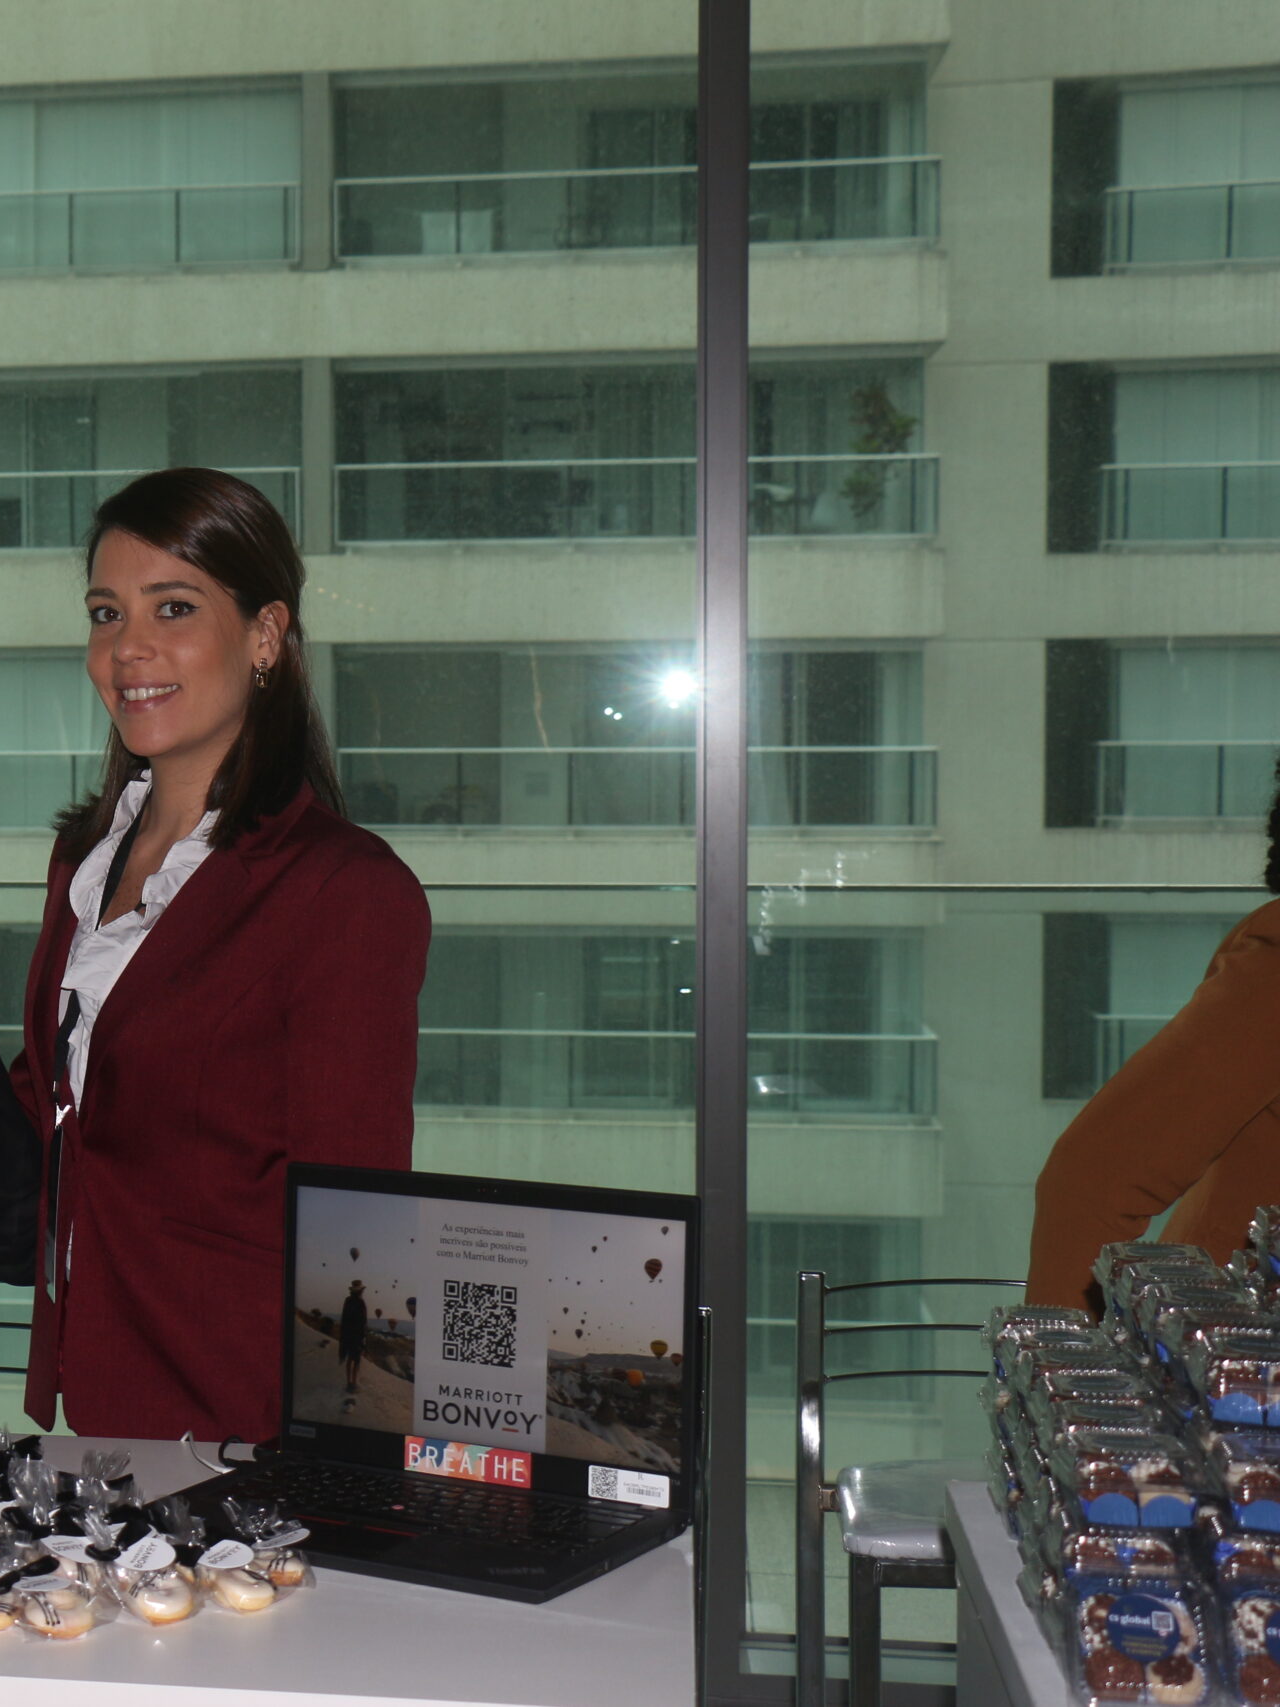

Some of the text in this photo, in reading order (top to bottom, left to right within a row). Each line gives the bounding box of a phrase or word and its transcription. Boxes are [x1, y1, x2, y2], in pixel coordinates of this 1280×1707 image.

[442, 1223, 453, 1232] As
[506, 1230, 525, 1239] mais
[475, 1239, 489, 1248] são
[436, 1249, 453, 1257] com
[463, 1251, 495, 1262] Marriott
[498, 1254, 529, 1267] Bonvoy
[439, 1384, 524, 1406] MARRIOTT
[423, 1399, 539, 1435] BONVOY
[408, 1443, 525, 1482] BREATHE
[134, 1542, 158, 1568] BONVOY
[1108, 1614, 1151, 1625] cs global
